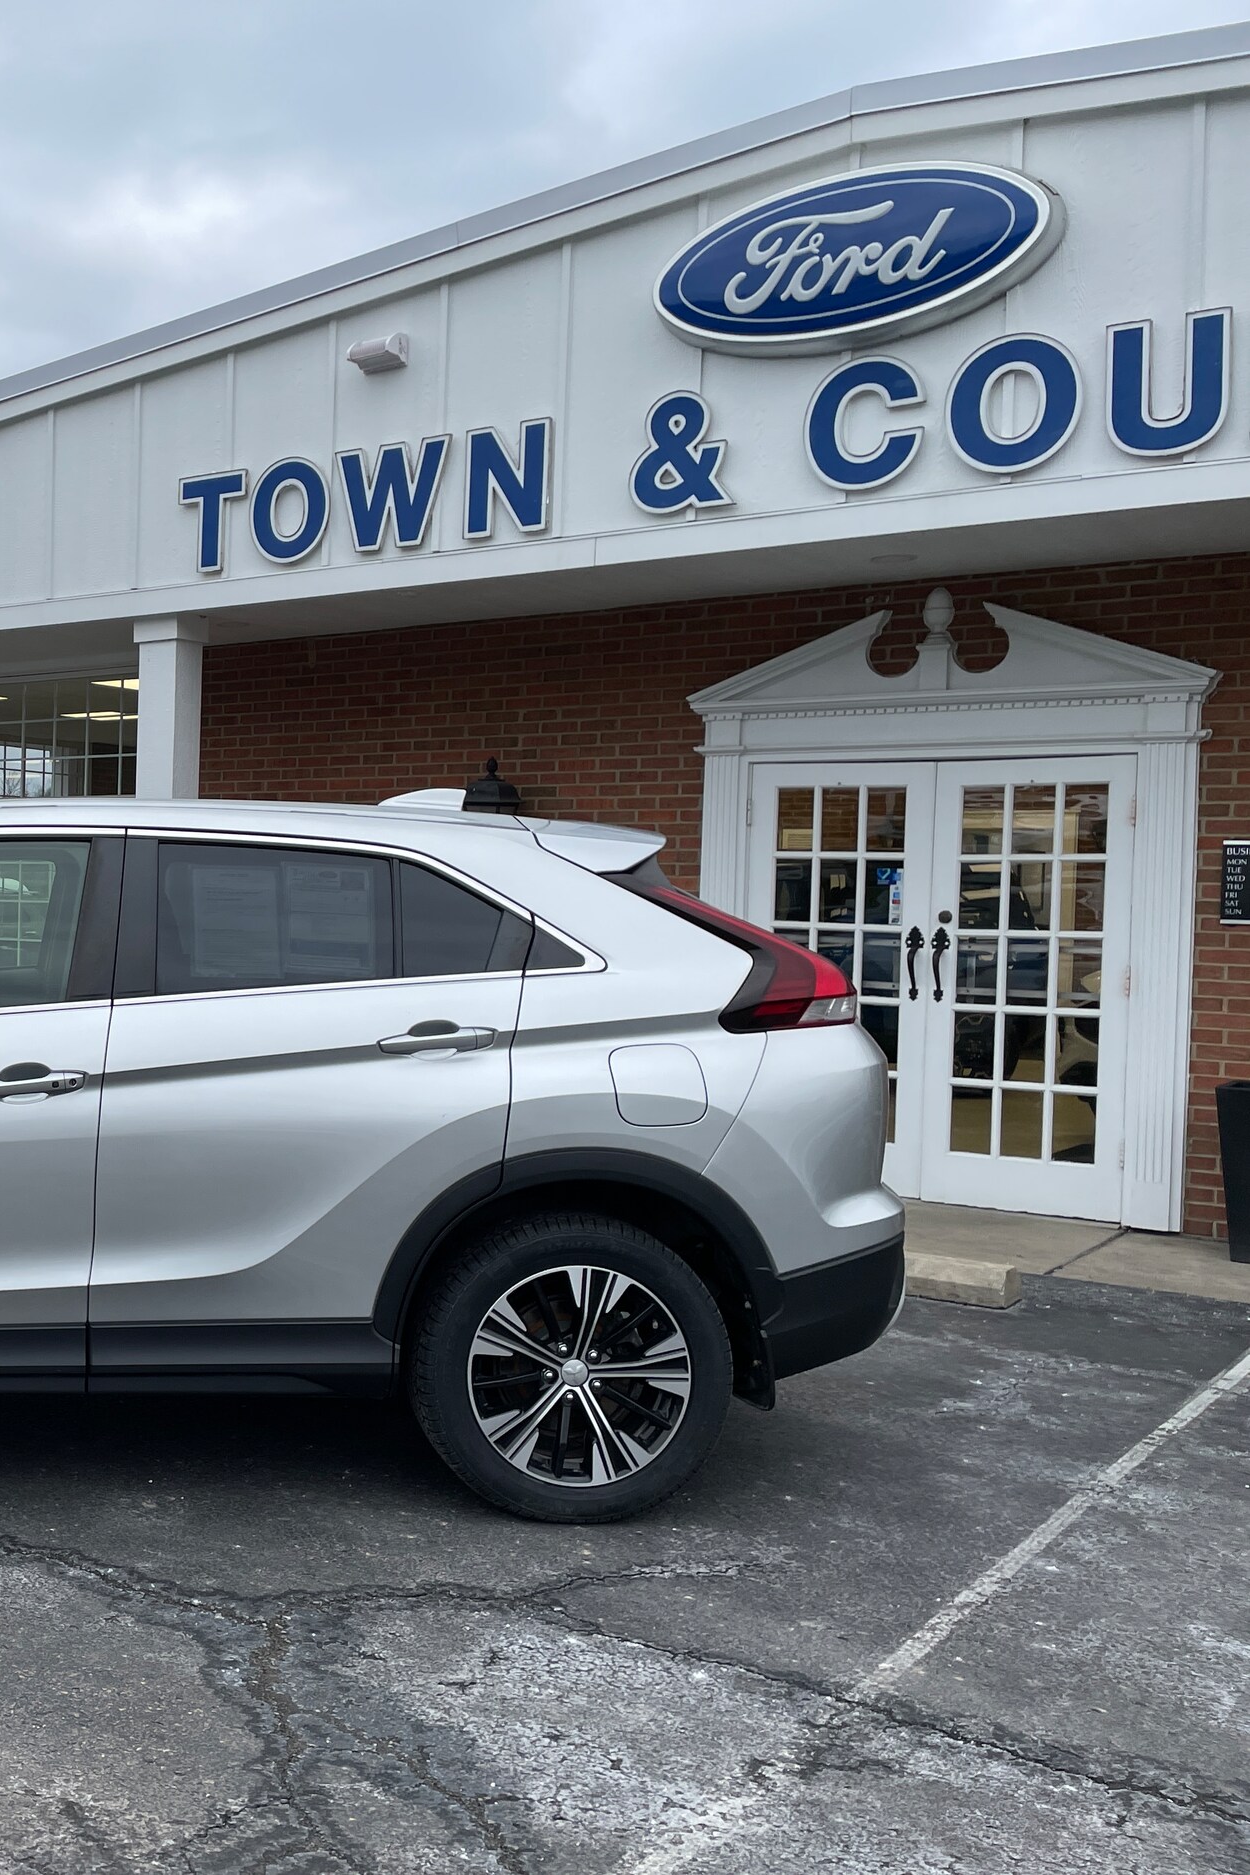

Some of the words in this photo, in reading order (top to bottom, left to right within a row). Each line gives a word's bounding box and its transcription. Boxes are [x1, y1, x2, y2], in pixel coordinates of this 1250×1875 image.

[723, 199, 955, 316] Ford
[178, 415, 553, 574] TOWN
[628, 389, 736, 515] &
[803, 306, 1240, 491] COU
[1226, 847, 1250, 855] BUSI
